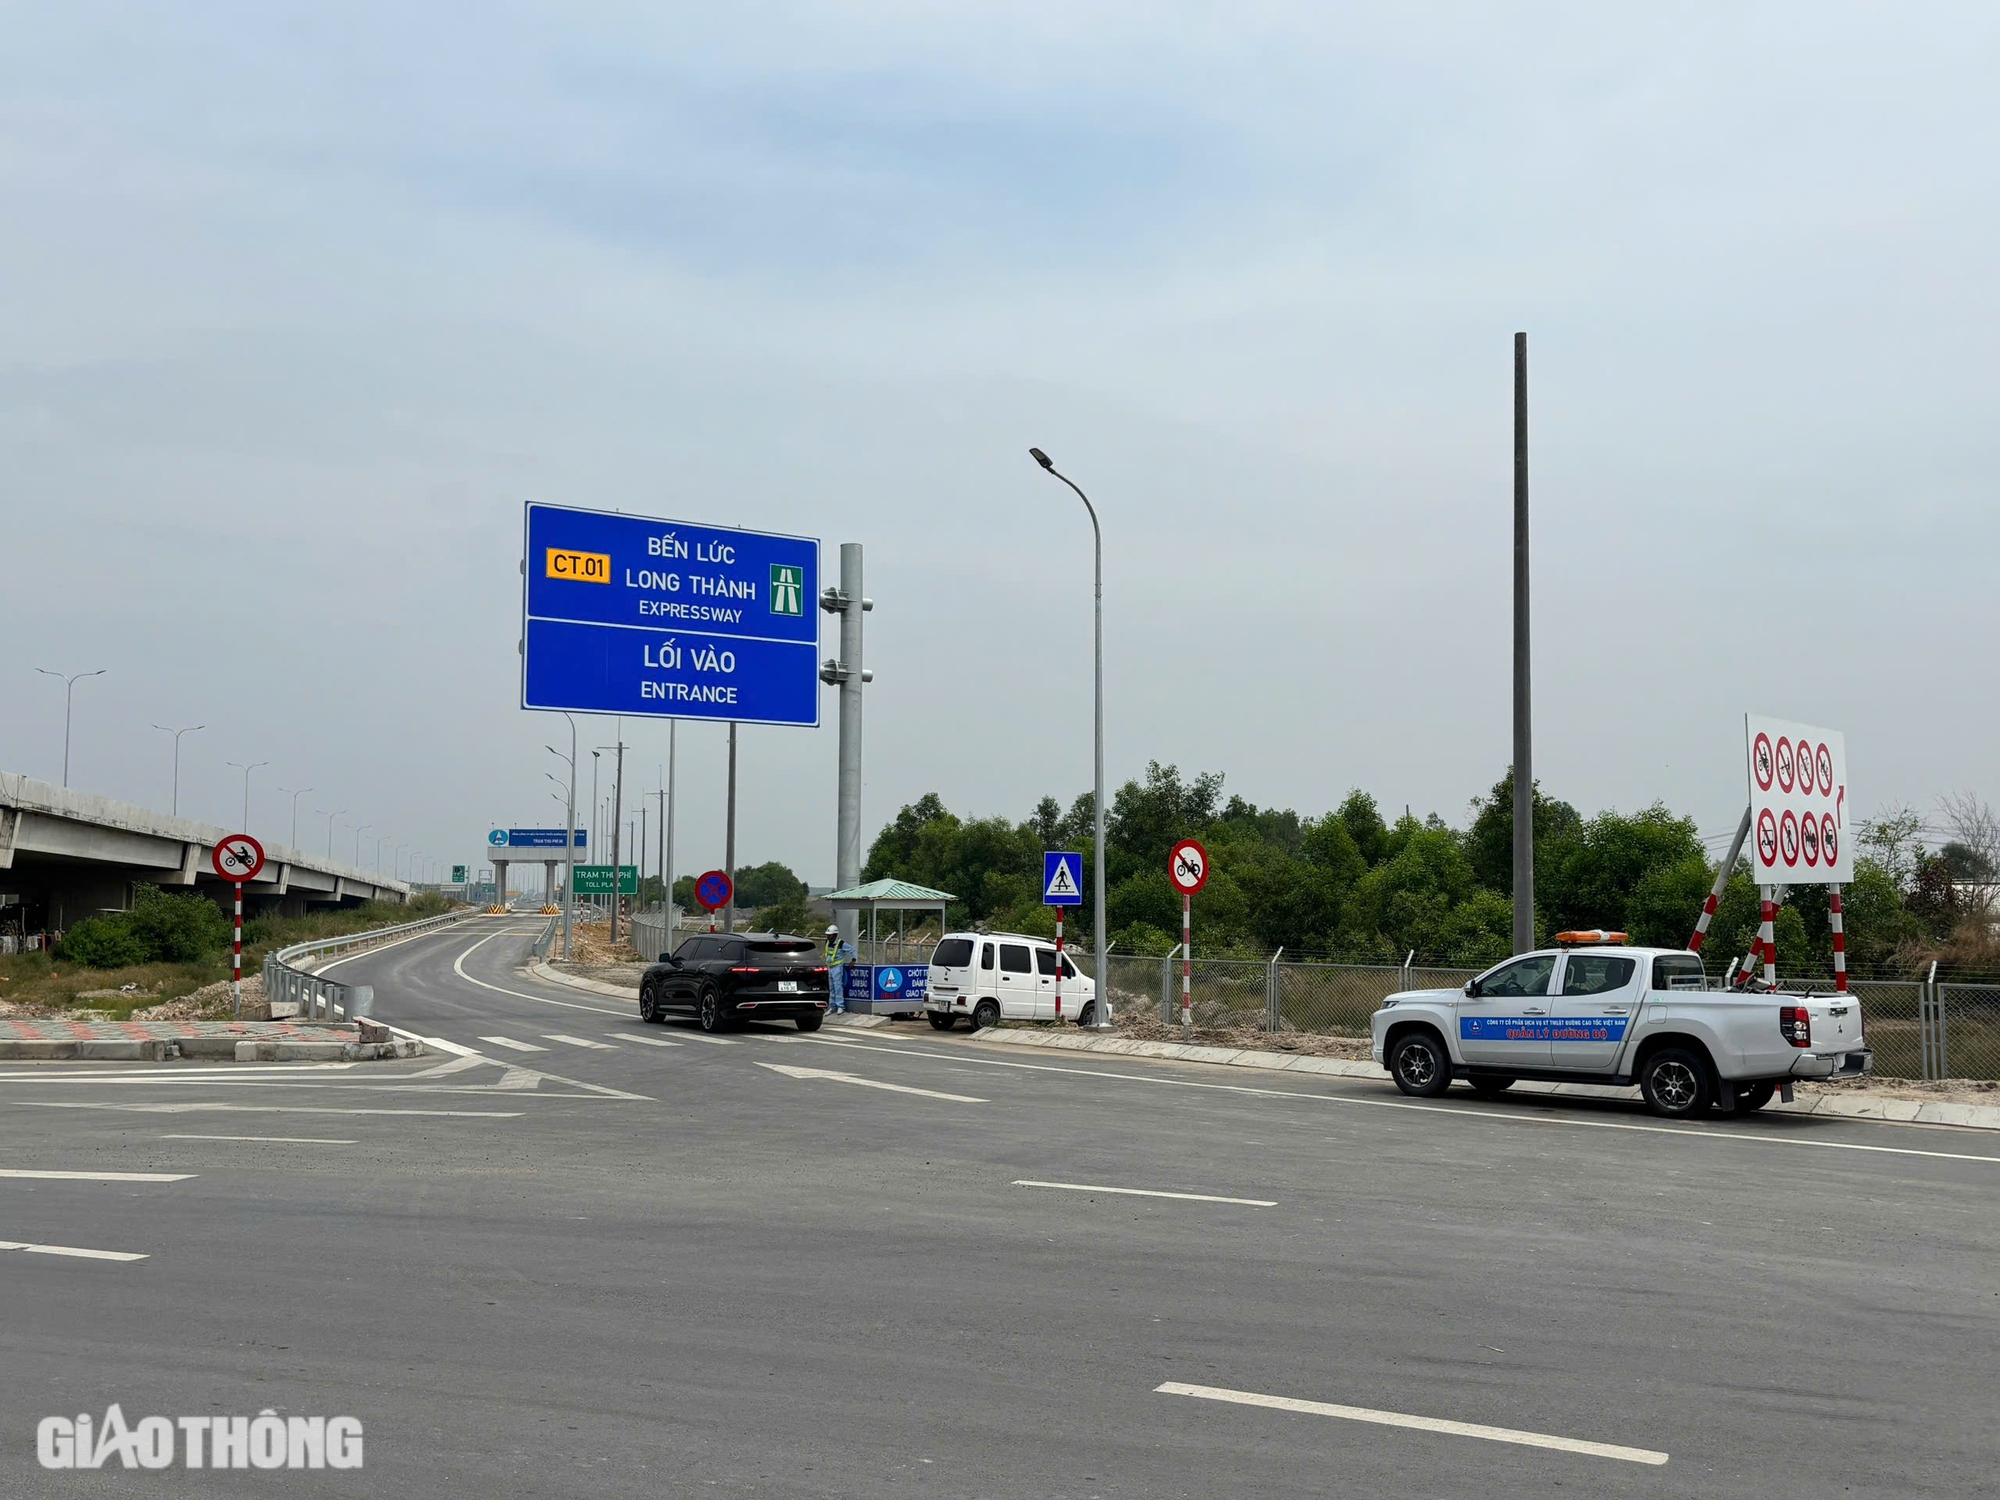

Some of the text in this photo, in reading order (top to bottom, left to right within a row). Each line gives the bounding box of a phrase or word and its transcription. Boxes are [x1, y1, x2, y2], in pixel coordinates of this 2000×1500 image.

[648, 532, 735, 564] BẾN LỨC
[554, 554, 603, 577] CT.01
[626, 568, 756, 600] LONG THÀNH
[639, 600, 742, 623] EXPRESSWAY
[644, 638, 735, 673] LỐI VÀO
[641, 681, 737, 704] ENTRANCE
[576, 871, 599, 879] TRẠM
[905, 989, 919, 997] GIAO
